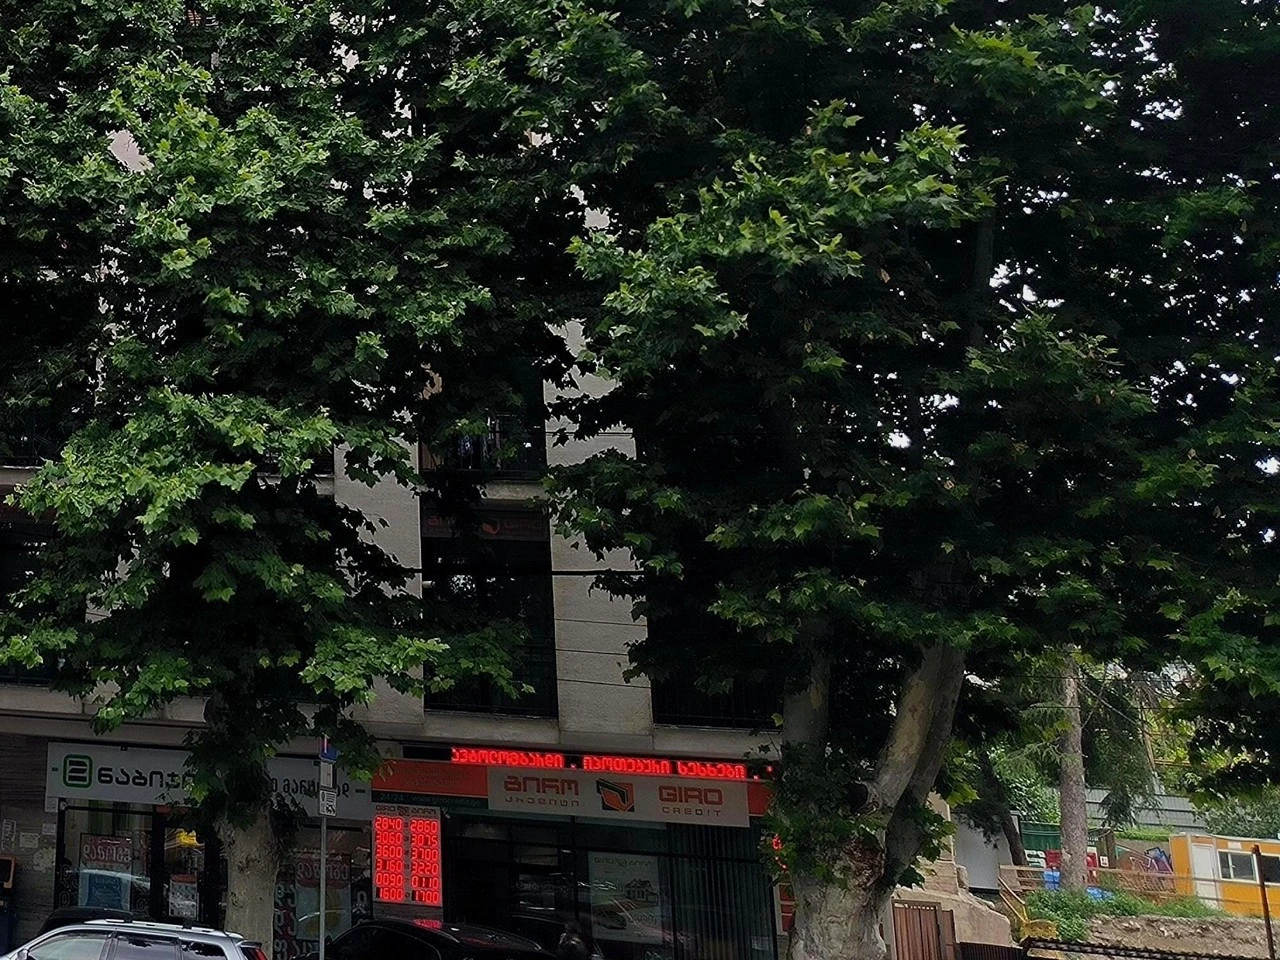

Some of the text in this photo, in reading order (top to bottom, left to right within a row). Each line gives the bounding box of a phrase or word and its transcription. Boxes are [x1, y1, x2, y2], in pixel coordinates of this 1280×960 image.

[503, 775, 579, 796] გირო
[657, 784, 723, 806] GIRO
[661, 806, 723, 817] CREDIT
[375, 817, 438, 833] 2840 2860
[376, 831, 438, 847] 3060 3075
[376, 844, 438, 861] 3600 3700
[376, 859, 439, 875] 3160 3220
[376, 872, 439, 889] 0090 0110
[379, 888, 439, 904] 1600 1700
